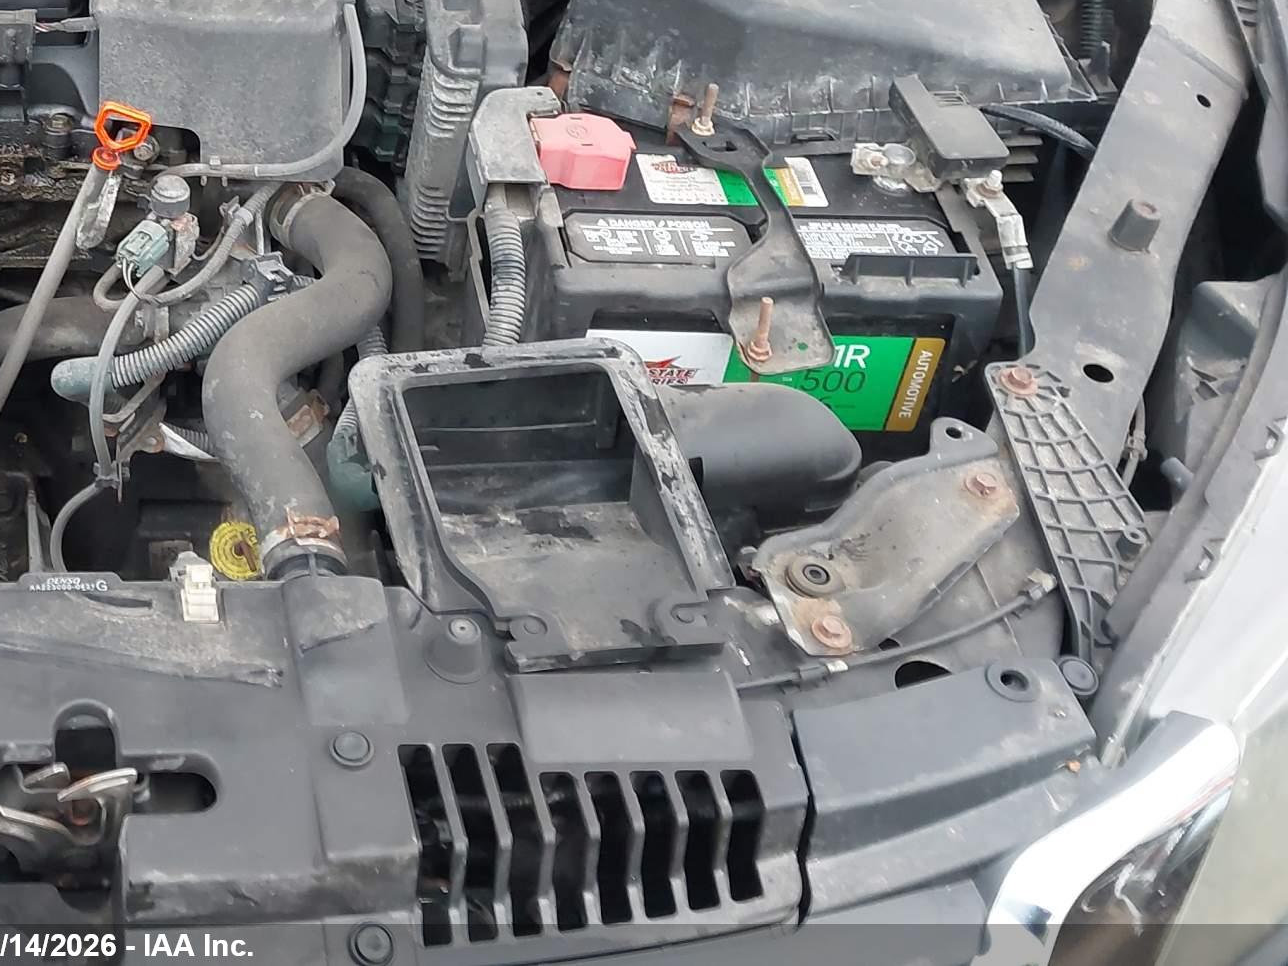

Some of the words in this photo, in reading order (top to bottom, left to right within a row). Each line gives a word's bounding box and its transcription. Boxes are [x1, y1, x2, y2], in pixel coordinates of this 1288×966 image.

[834, 344, 871, 369] 1R
[648, 368, 698, 379] STATE
[898, 349, 933, 419] AUTOMOTIVE
[46, 577, 81, 585] DENSO
